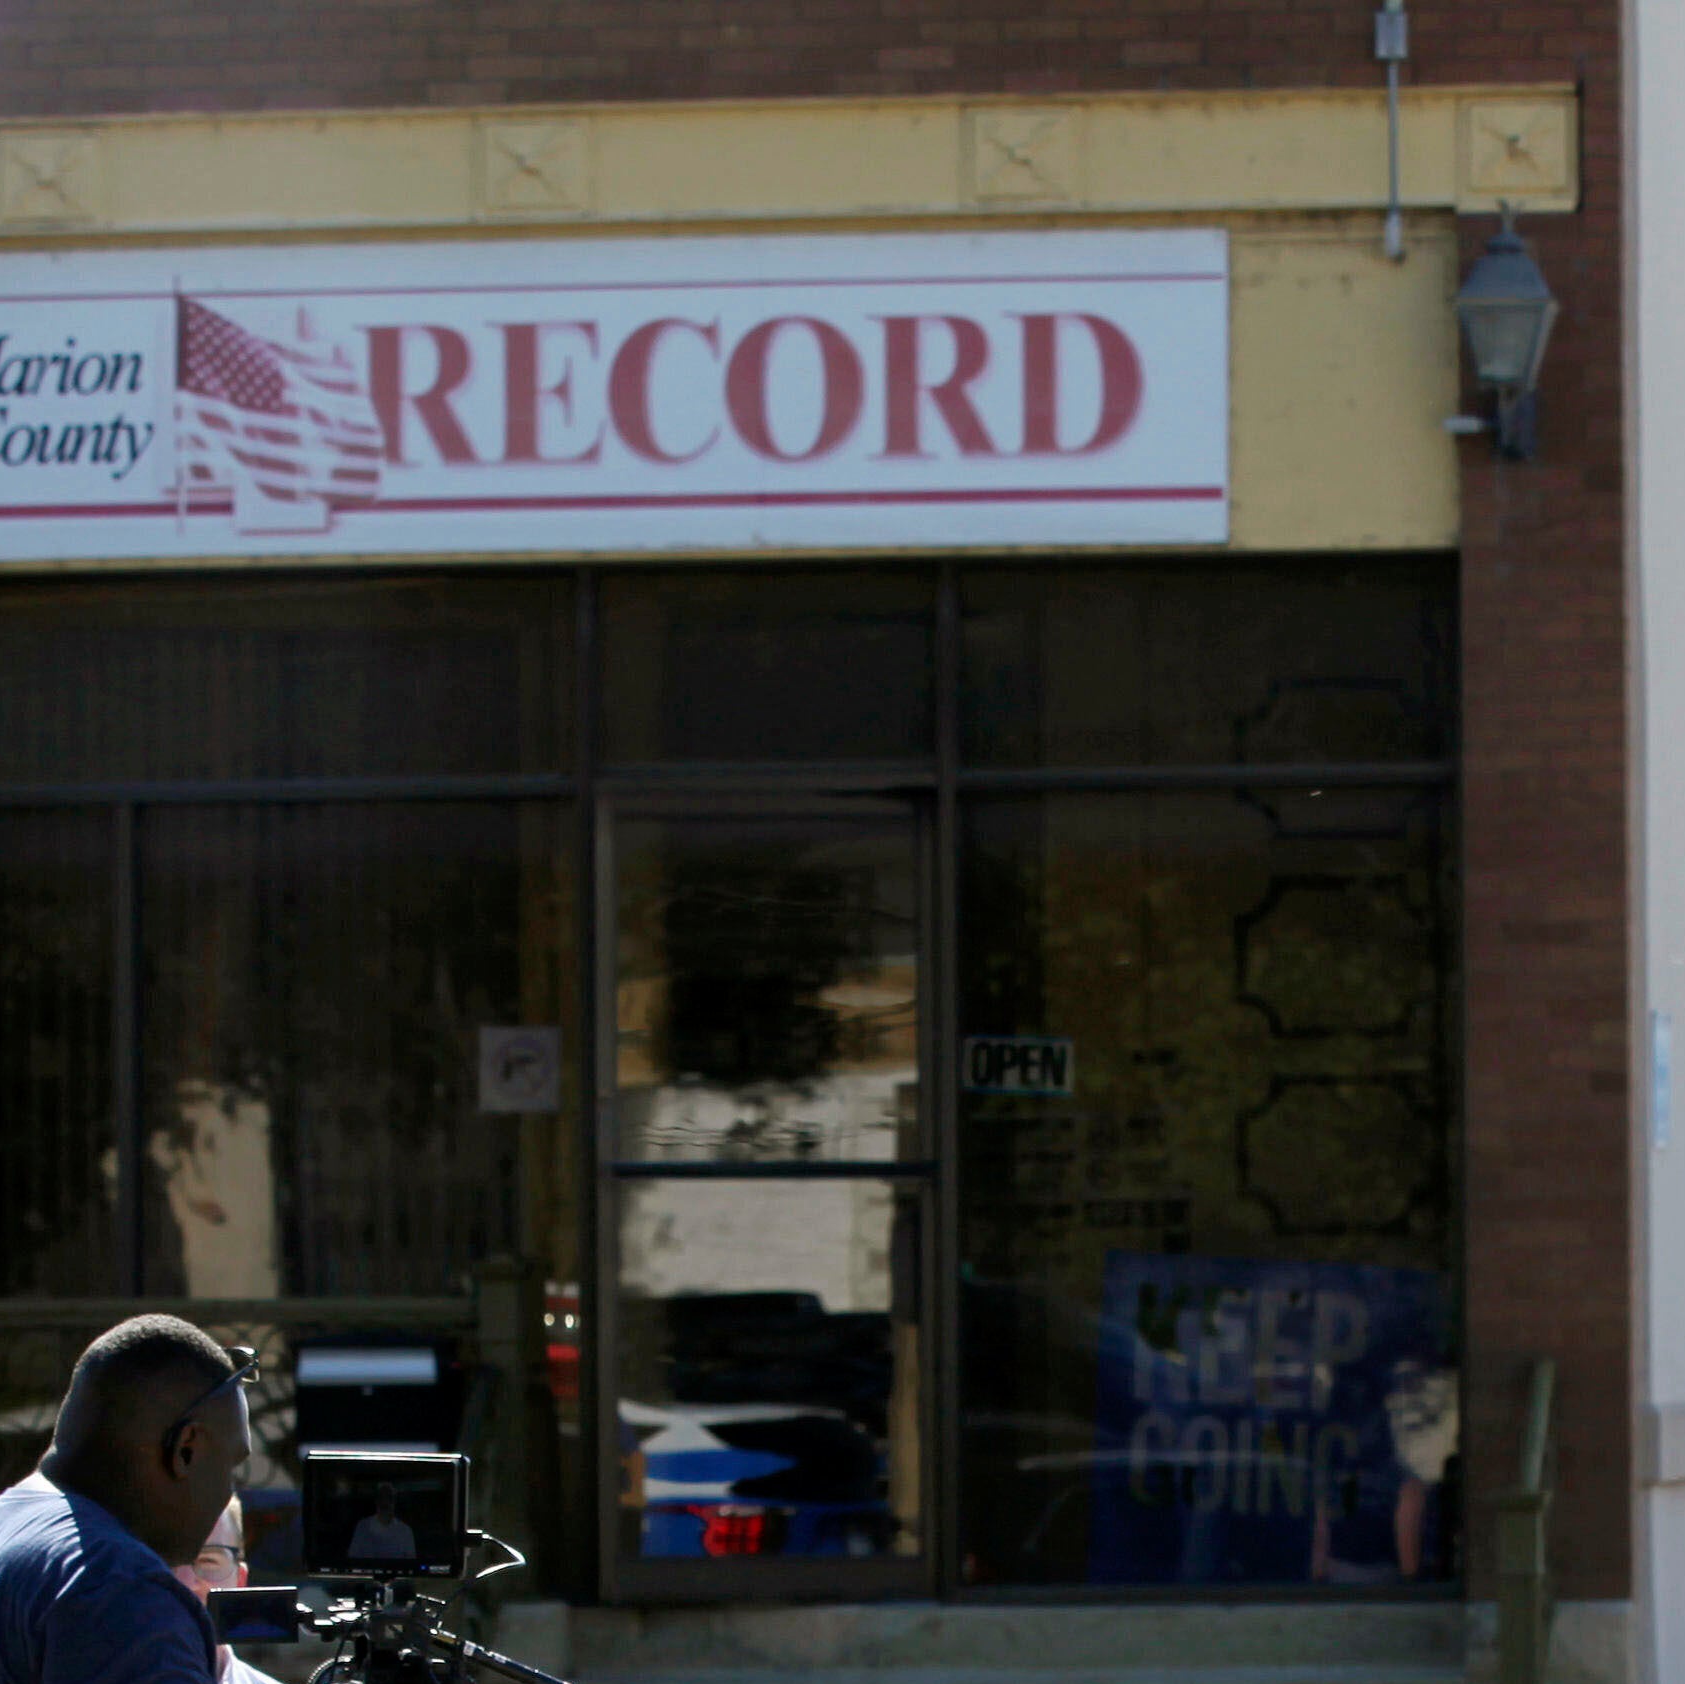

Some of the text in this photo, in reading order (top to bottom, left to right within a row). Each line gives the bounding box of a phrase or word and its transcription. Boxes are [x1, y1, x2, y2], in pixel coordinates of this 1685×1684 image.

[356, 312, 1145, 468] RECORD
[972, 1041, 1067, 1086] OPEN
[1128, 1410, 1360, 1518] GOING
